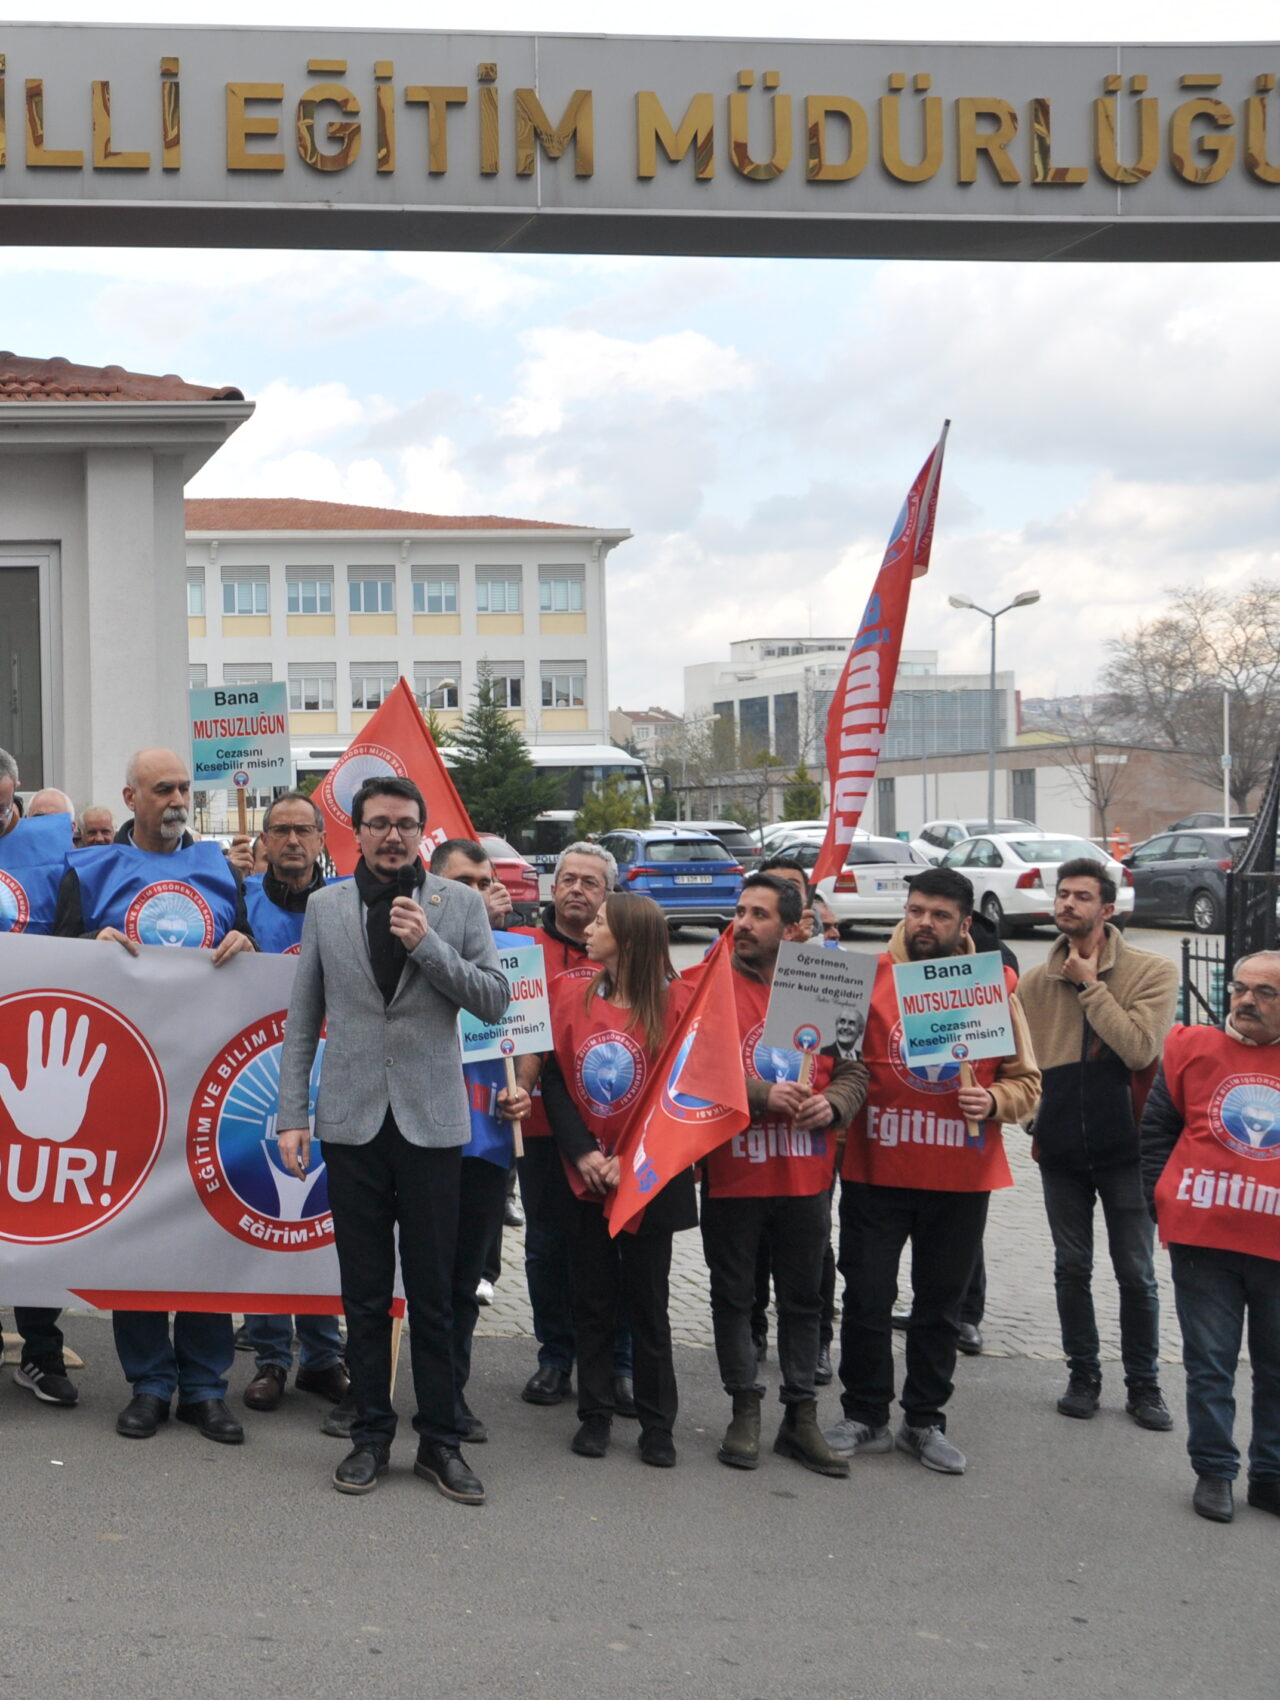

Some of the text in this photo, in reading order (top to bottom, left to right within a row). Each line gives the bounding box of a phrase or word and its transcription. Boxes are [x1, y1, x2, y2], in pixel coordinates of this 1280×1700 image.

[226, 59, 593, 177] EĞİTİM
[214, 691, 259, 706] Bana
[193, 711, 285, 740] MUTSUZLUĞUN
[216, 748, 263, 759] Cezasını
[196, 757, 284, 772] Kesebilir misin?
[796, 953, 849, 971] Öğretmen,
[778, 967, 817, 979] egemen
[923, 963, 972, 980] Bana
[773, 980, 795, 989] emir
[798, 983, 819, 993] kulu
[902, 982, 1003, 1015] MUTSUZLUĞUN
[464, 1021, 545, 1043] Kesebilir misin?
[930, 1019, 981, 1033] Cezasını
[909, 1026, 1005, 1048] Kesebilir misin?
[193, 1029, 268, 1193] EĞİTİM VE BİLİM
[238, 1213, 334, 1244] EĞİTİM-İŞ
